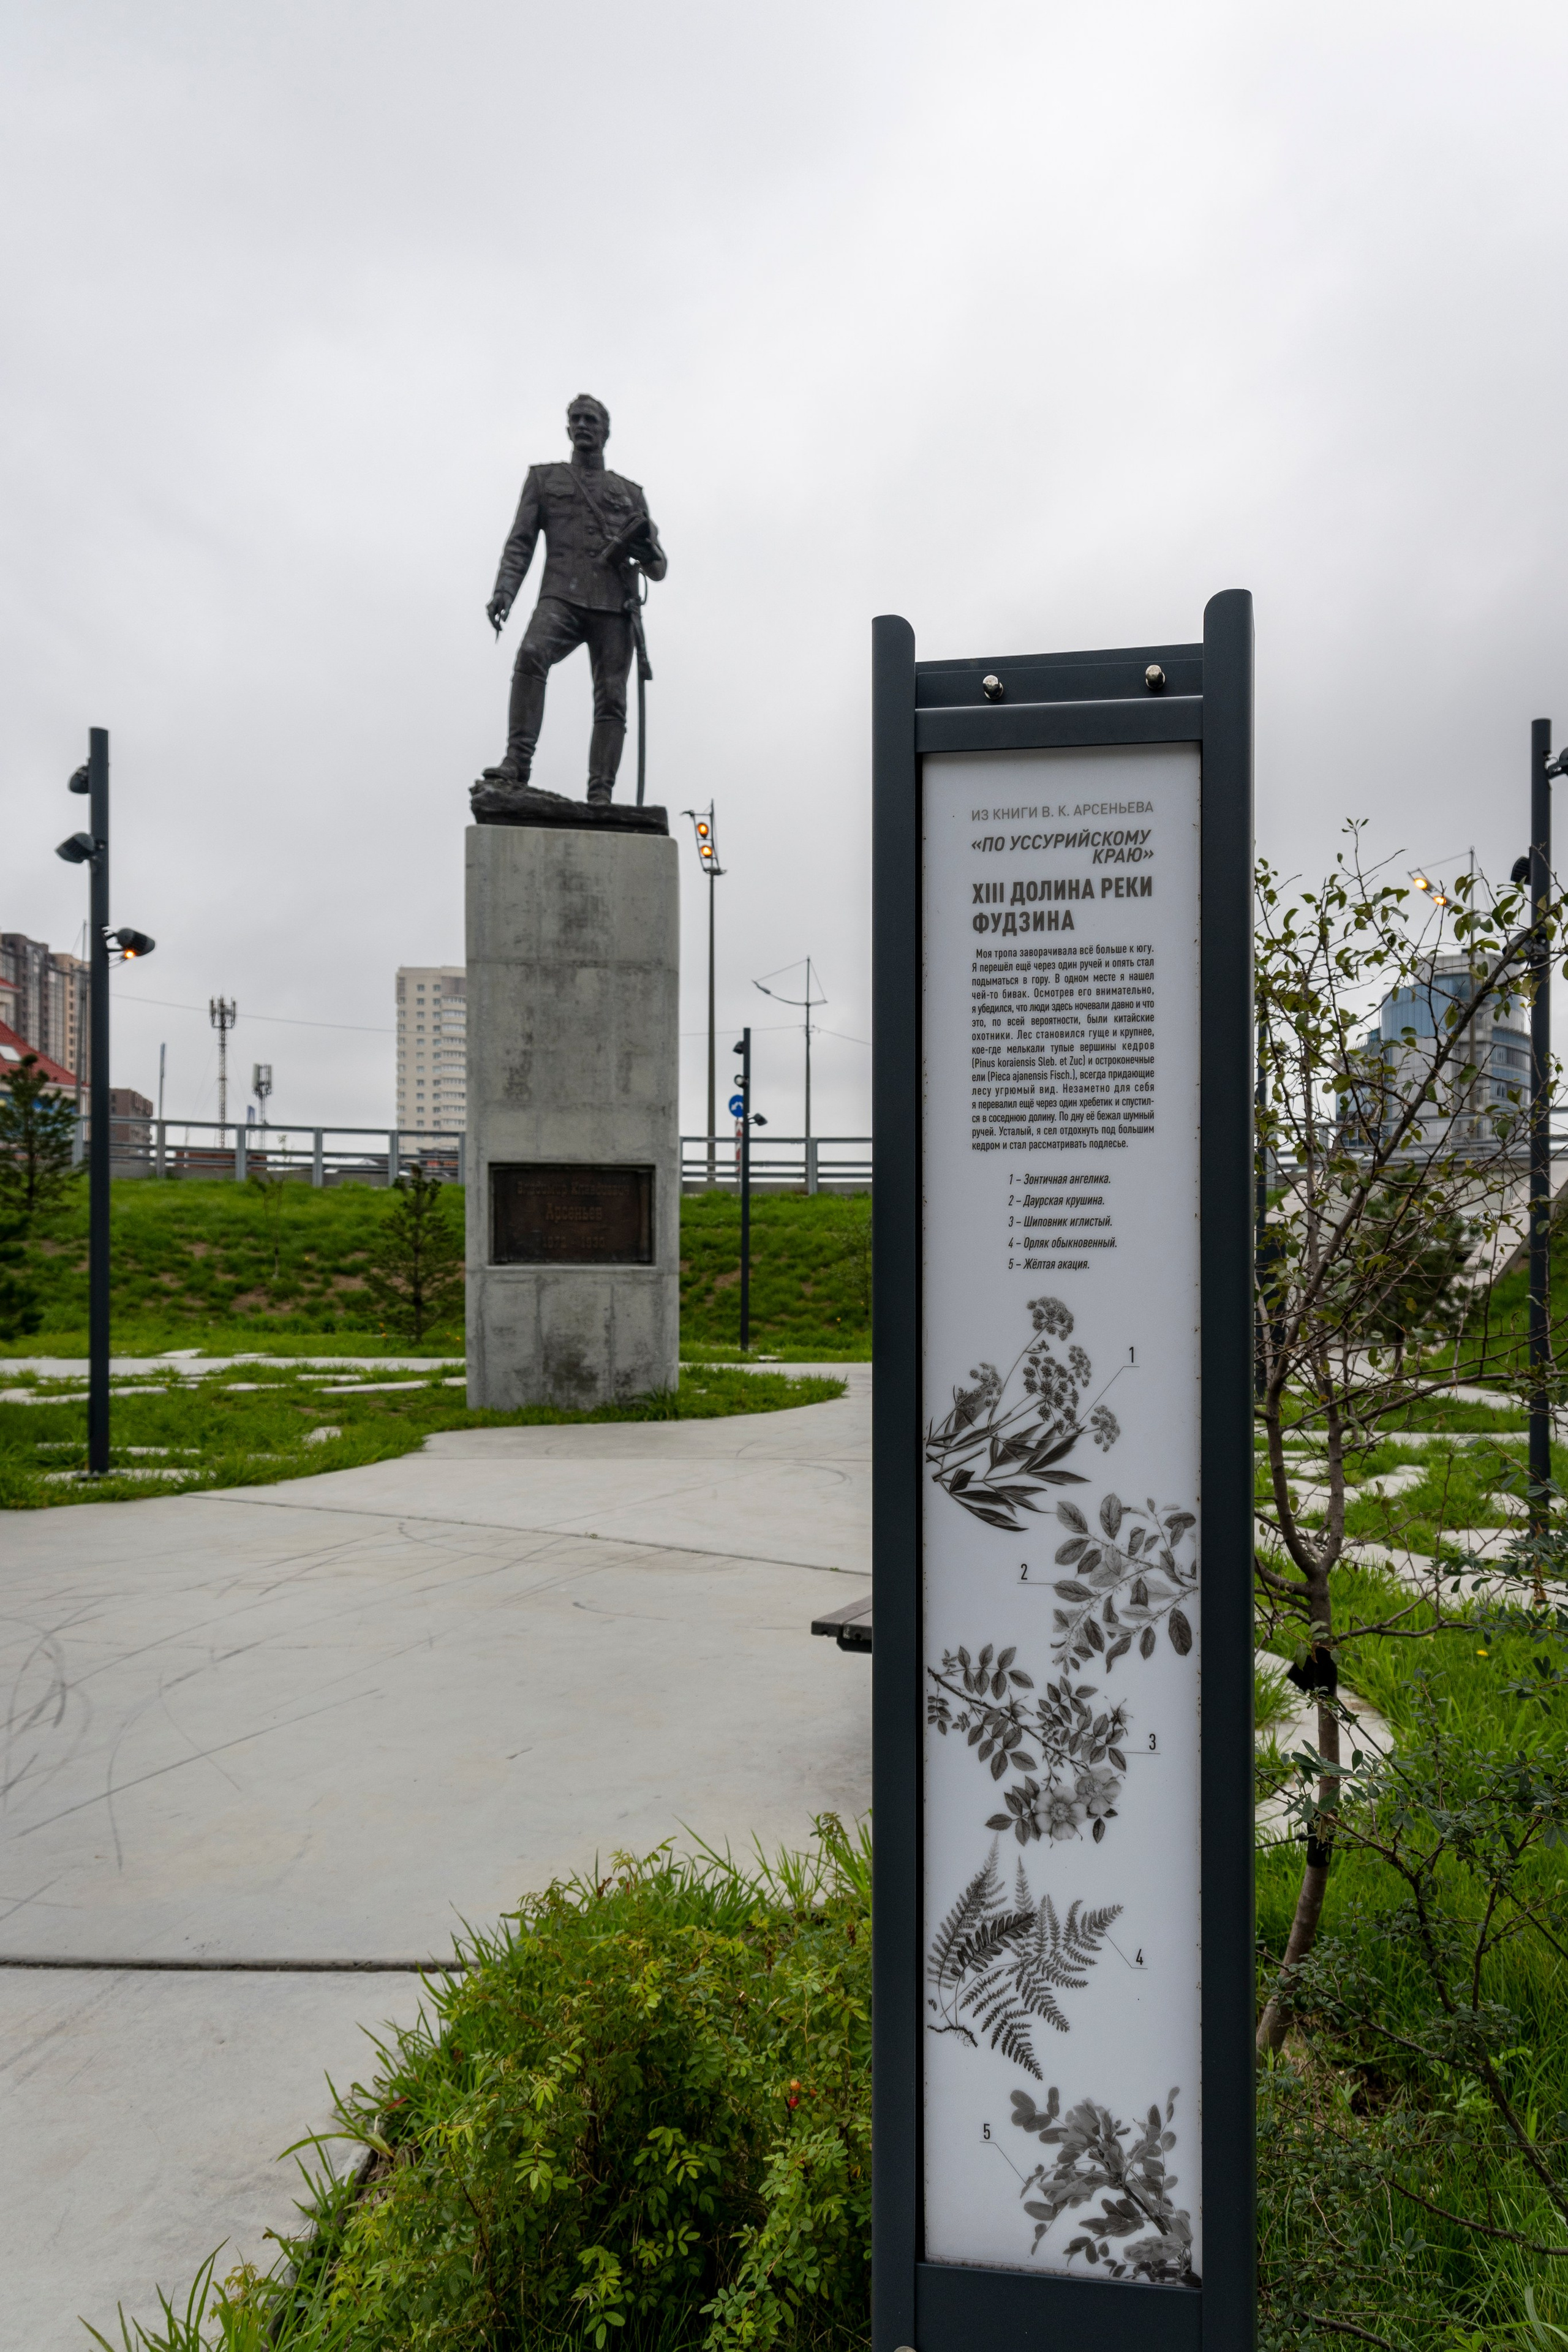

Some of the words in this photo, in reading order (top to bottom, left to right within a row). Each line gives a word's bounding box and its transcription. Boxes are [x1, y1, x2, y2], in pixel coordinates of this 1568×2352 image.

[972, 809, 989, 821] ИЗ
[993, 807, 1038, 820] КНИГИ
[1042, 806, 1054, 817] В.
[1058, 805, 1069, 816] К.
[1074, 801, 1153, 816] АРСЕНЬЕВА
[971, 837, 1005, 852] «ПО
[1009, 829, 1152, 851] УССУРИЙСКОМУ
[1093, 847, 1154, 864] КРАЮ»
[1011, 878, 1095, 907] ДОЛИНА
[1101, 876, 1152, 899] РЕКИ
[973, 910, 1074, 937] ФУДЗИНА
[976, 949, 992, 958] Моя
[994, 949, 1017, 960] тропа
[1019, 948, 1077, 959] заворачивала
[1079, 945, 1093, 955] всё
[1096, 944, 1127, 954] больше
[1137, 944, 1154, 954] югу.
[972, 963, 977, 972] Я
[980, 962, 1013, 974] перешёл
[1016, 961, 1031, 972] ещё
[1034, 962, 1055, 972] через
[1058, 962, 1077, 971] один
[1080, 959, 1102, 971] ручей
[1112, 959, 1134, 968] опять
[972, 978, 1019, 987] подыматься
[1032, 976, 1050, 986] гору.
[1055, 973, 1060, 983] В
[1065, 975, 1088, 984] одном
[972, 990, 998, 1000] чей-то
[1002, 989, 1029, 998] бивак.
[1034, 988, 1074, 999] Осмотрев
[1096, 987, 1154, 996] внимательно,
[978, 1003, 1014, 1016] убедился,
[1029, 1004, 1050, 1013] люди
[1052, 1003, 1073, 1012] здесь
[1111, 1001, 1134, 1011] давно
[972, 1019, 986, 1028] это,
[1007, 1016, 1025, 1026] всей
[1031, 1017, 1080, 1027] вероятности,
[1087, 1014, 1107, 1023] были
[1114, 1013, 1154, 1023] китайские
[1017, 1030, 1032, 1039] Лес
[1036, 1030, 1085, 1039] становился
[1089, 1030, 1109, 1039] гуще
[1120, 1028, 1154, 1039] крупнее,
[972, 1046, 1001, 1055] кое-где
[1007, 1045, 1044, 1054] мелькали
[1050, 1044, 1074, 1054] тупые
[1080, 1044, 1116, 1054] вершины
[1122, 1042, 1155, 1052] кедров
[972, 1057, 995, 1069] (Pinus
[998, 1057, 1036, 1067] koraiensis
[1038, 1057, 1057, 1066] Sleb.
[1060, 1057, 1067, 1066] et
[1069, 1055, 1085, 1066] Zuc)
[1095, 1056, 1155, 1067] остроконечные
[987, 1071, 1011, 1082] (Pieca
[1012, 1071, 1048, 1083] ajanensis
[1050, 1068, 1077, 1080] Fisch.),
[1080, 1071, 1106, 1080] всегда
[1109, 1070, 1154, 1080] придающие
[971, 1088, 991, 1097] лесу
[995, 1084, 1035, 1097] угрюмый
[1039, 1086, 1058, 1095] вид.
[1063, 1084, 1110, 1093] Незаметно
[1114, 1085, 1130, 1094] для
[1134, 1082, 1154, 1091] себя
[978, 1101, 1017, 1111] перевалил
[1019, 1098, 1034, 1109] ещё
[1036, 1100, 1057, 1110] через
[1059, 1099, 1077, 1109] один
[1079, 1096, 1113, 1109] хребетик
[1122, 1098, 1154, 1108] спустил-
[989, 1114, 1027, 1123] соседнюю
[1028, 1114, 1057, 1123] долину.
[1060, 1111, 1068, 1121] По
[1071, 1114, 1084, 1123] дну
[1086, 1111, 1095, 1120] её
[1097, 1110, 1121, 1120] бежал
[1123, 1110, 1154, 1122] шумный
[972, 1127, 996, 1139] ручей.
[999, 1126, 1033, 1136] Усталый,
[1060, 1127, 1099, 1137] отдохнуть
[1101, 1126, 1116, 1136] под
[1118, 1124, 1154, 1134] большим
[972, 1142, 1000, 1152] кедром
[1029, 1140, 1087, 1152] рассматривать
[1089, 1140, 1128, 1150] подлесье.
[1009, 1174, 1013, 1185] 1
[1023, 1174, 1068, 1185] Зонтичная
[1069, 1175, 1110, 1184] ангелика.
[1008, 1195, 1014, 1206] 2
[1023, 1194, 1063, 1208] Даурская
[1066, 1197, 1104, 1208] крушина.
[545, 1202, 603, 1224] Арсеньев
[1008, 1216, 1014, 1227] 3
[1023, 1216, 1068, 1227] Шиповник
[1069, 1215, 1112, 1226] иглистый.
[1008, 1237, 1014, 1248] 4
[1023, 1237, 1050, 1250] Орляк
[1051, 1237, 1117, 1248] обыкновенный.
[1008, 1258, 1014, 1269] 5
[1023, 1258, 1056, 1269] Жёлтая
[1057, 1261, 1090, 1271] акация.
[1129, 1346, 1134, 1363] 1
[1020, 1563, 1028, 1580] 2
[1148, 1733, 1156, 1751] 3
[1136, 1948, 1144, 1966] 4
[983, 2123, 990, 2140] 5
